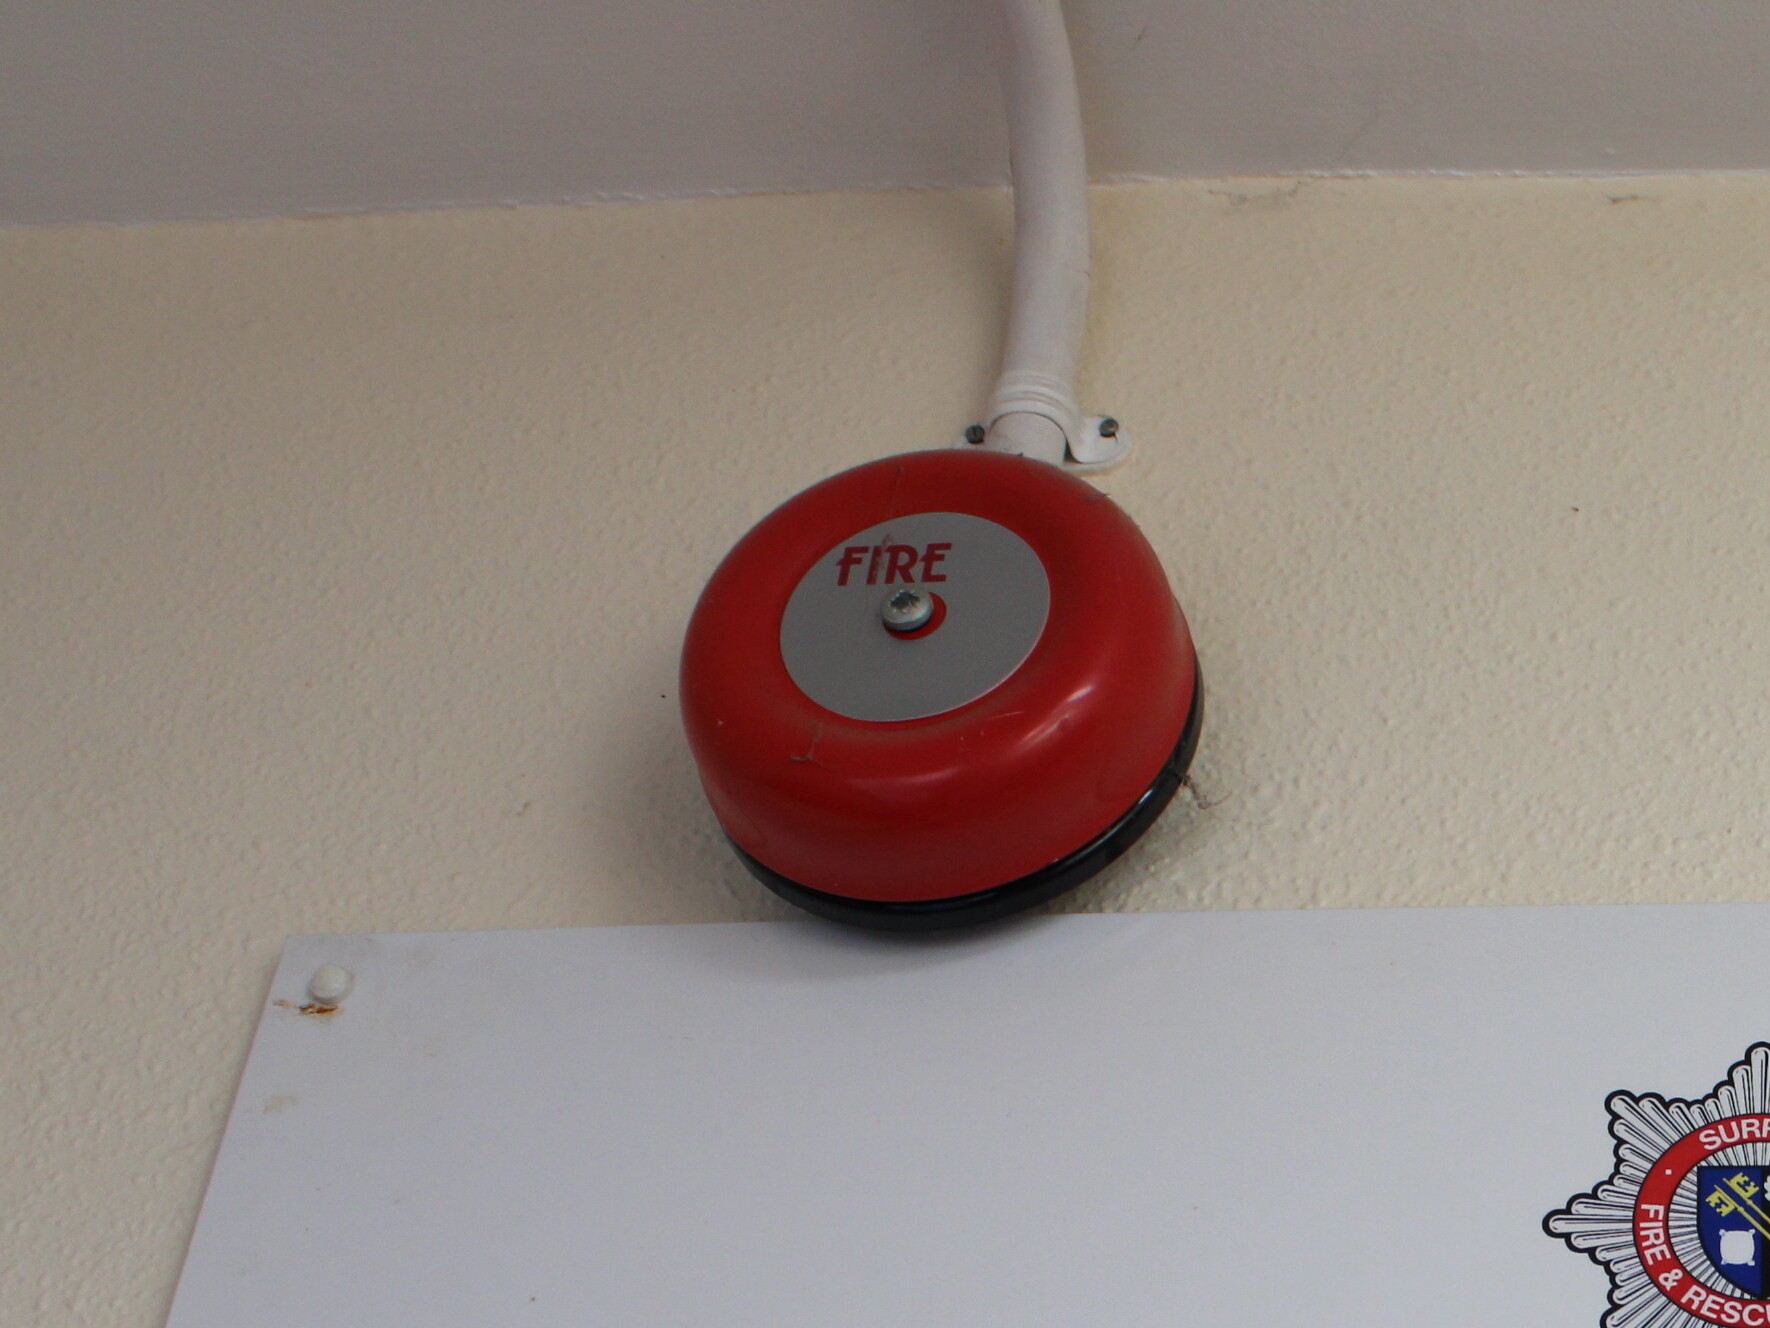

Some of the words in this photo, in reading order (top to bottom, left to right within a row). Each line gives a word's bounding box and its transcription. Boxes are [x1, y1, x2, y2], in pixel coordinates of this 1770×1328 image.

[836, 543, 952, 586] FIRE
[1640, 1203, 1671, 1266] FIRE
[1658, 1268, 1684, 1291] &
